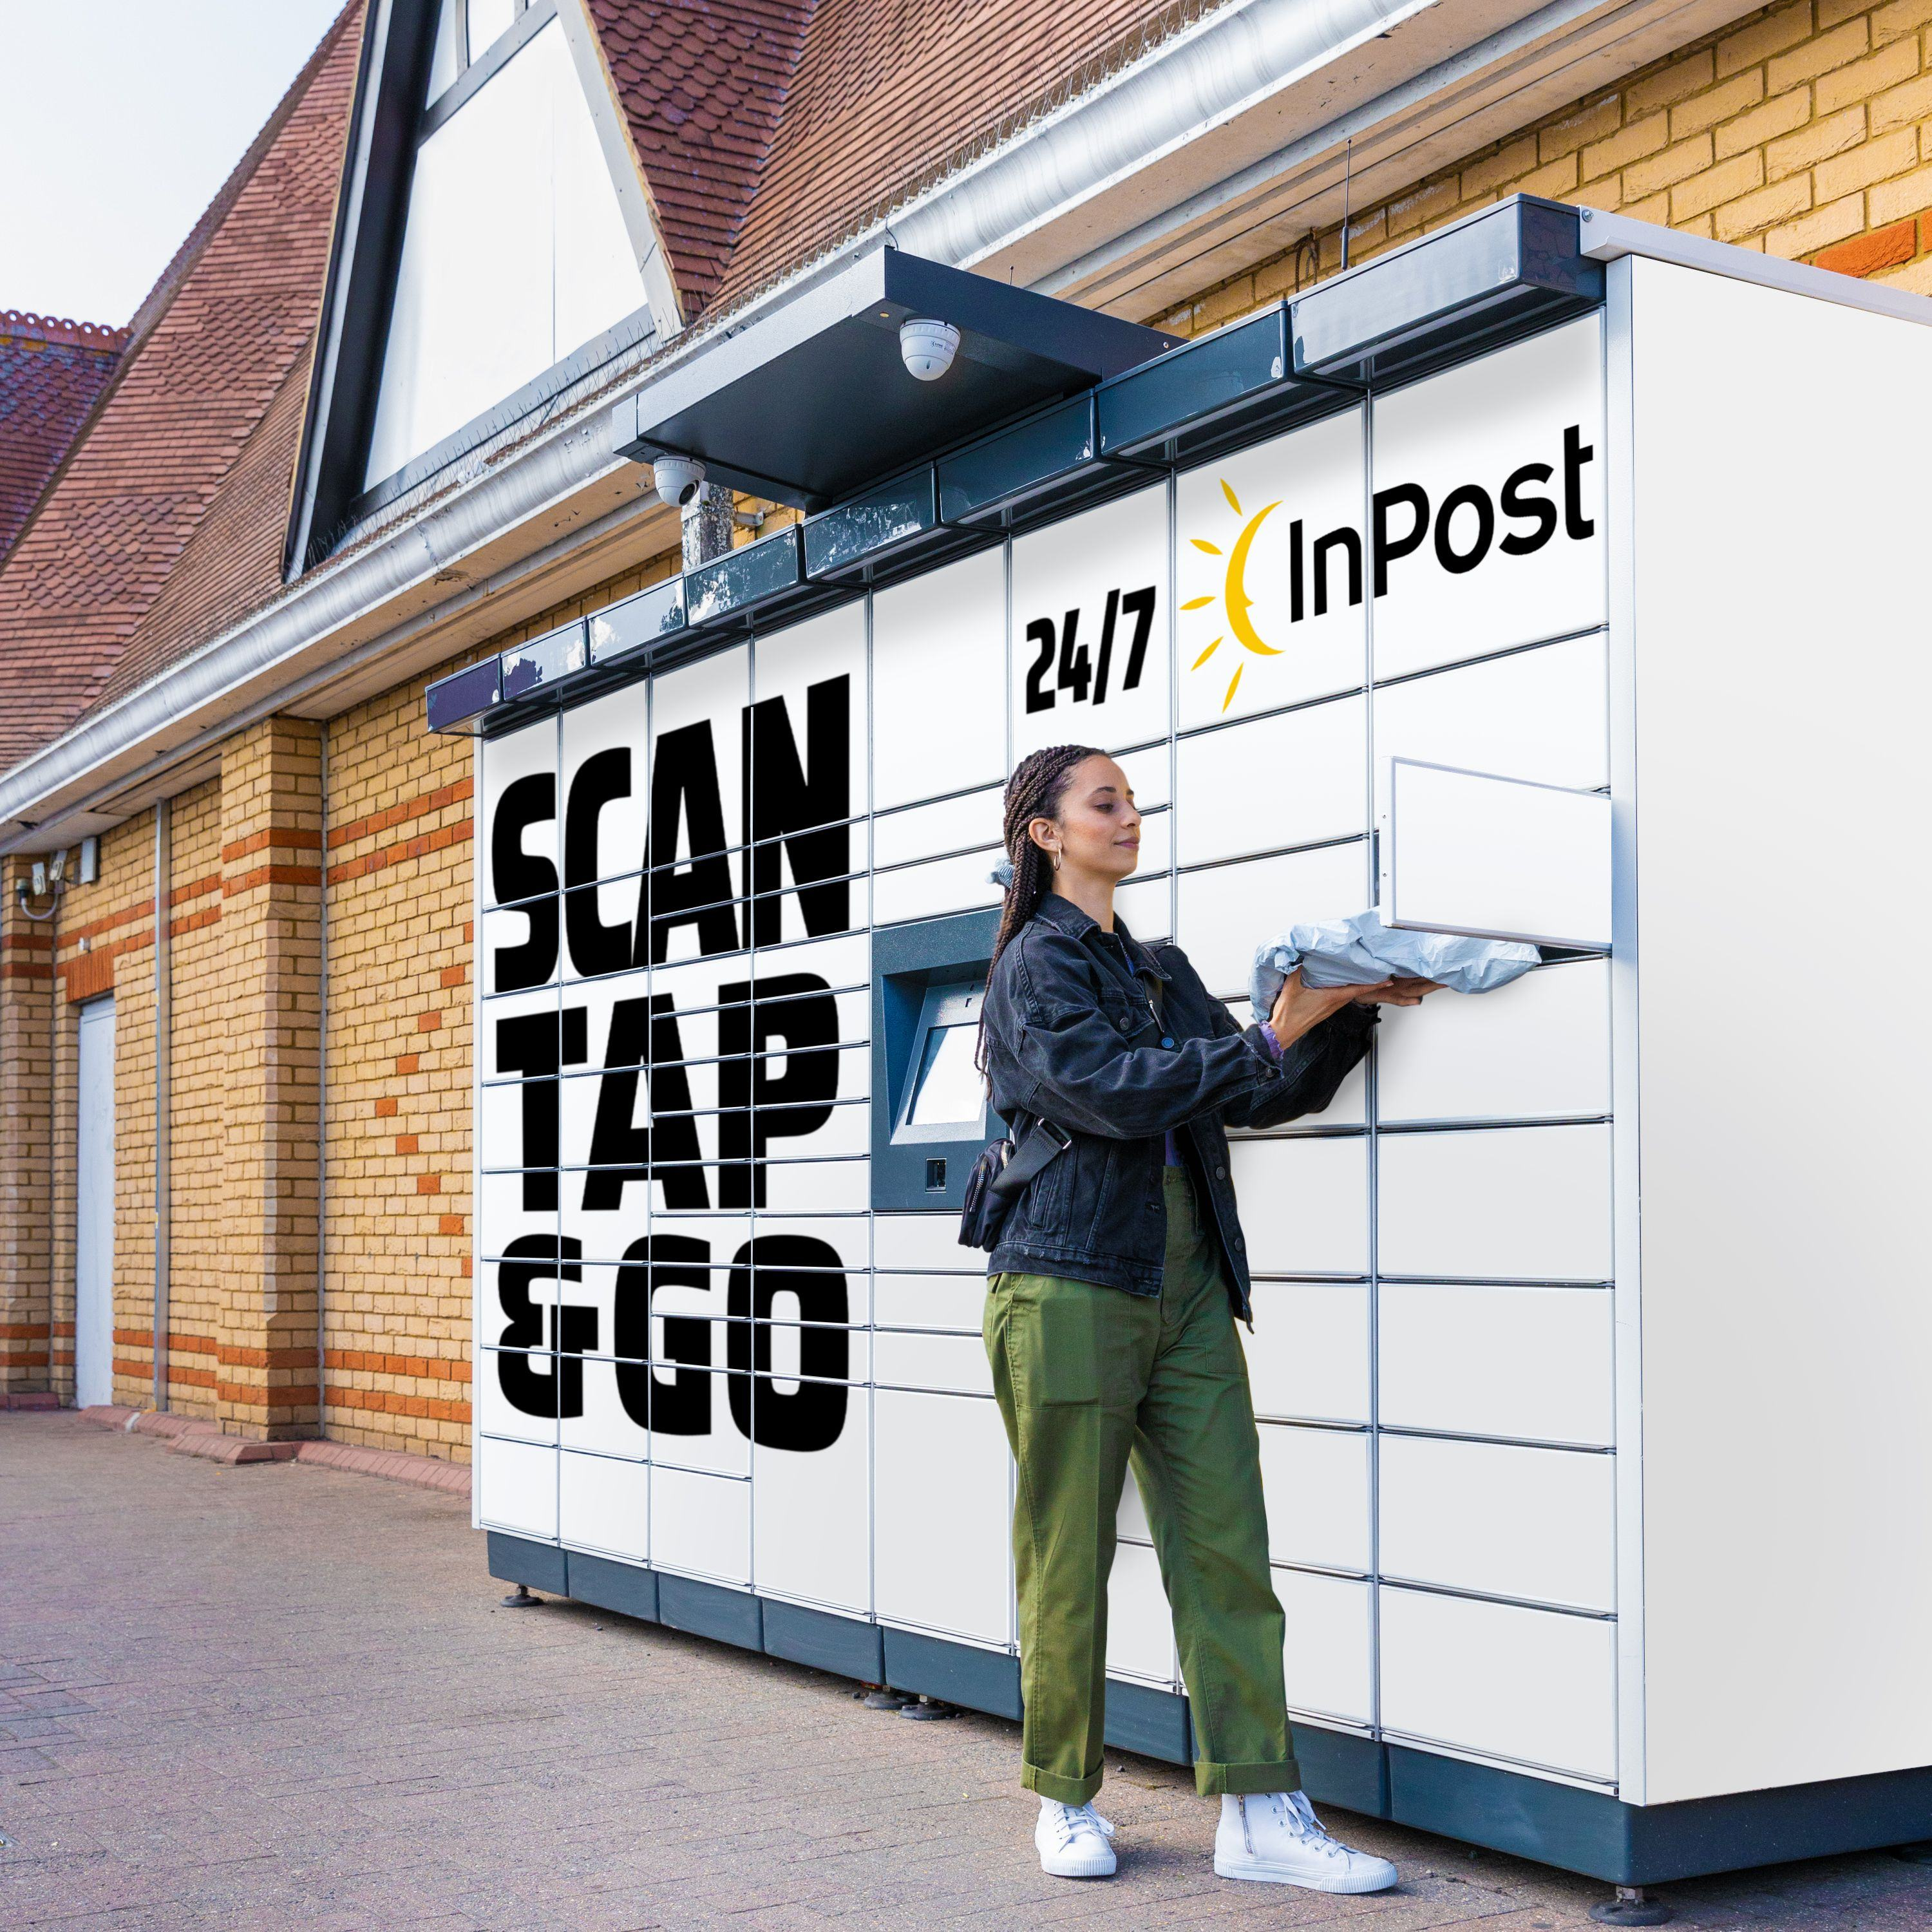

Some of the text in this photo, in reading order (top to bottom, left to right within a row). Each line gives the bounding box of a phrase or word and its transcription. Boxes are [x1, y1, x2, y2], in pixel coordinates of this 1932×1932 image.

[1027, 424, 1594, 714] 24/7 InPost
[492, 674, 849, 992] SCAN
[497, 973, 838, 1211] TAP
[498, 1234, 849, 1452] &GO
